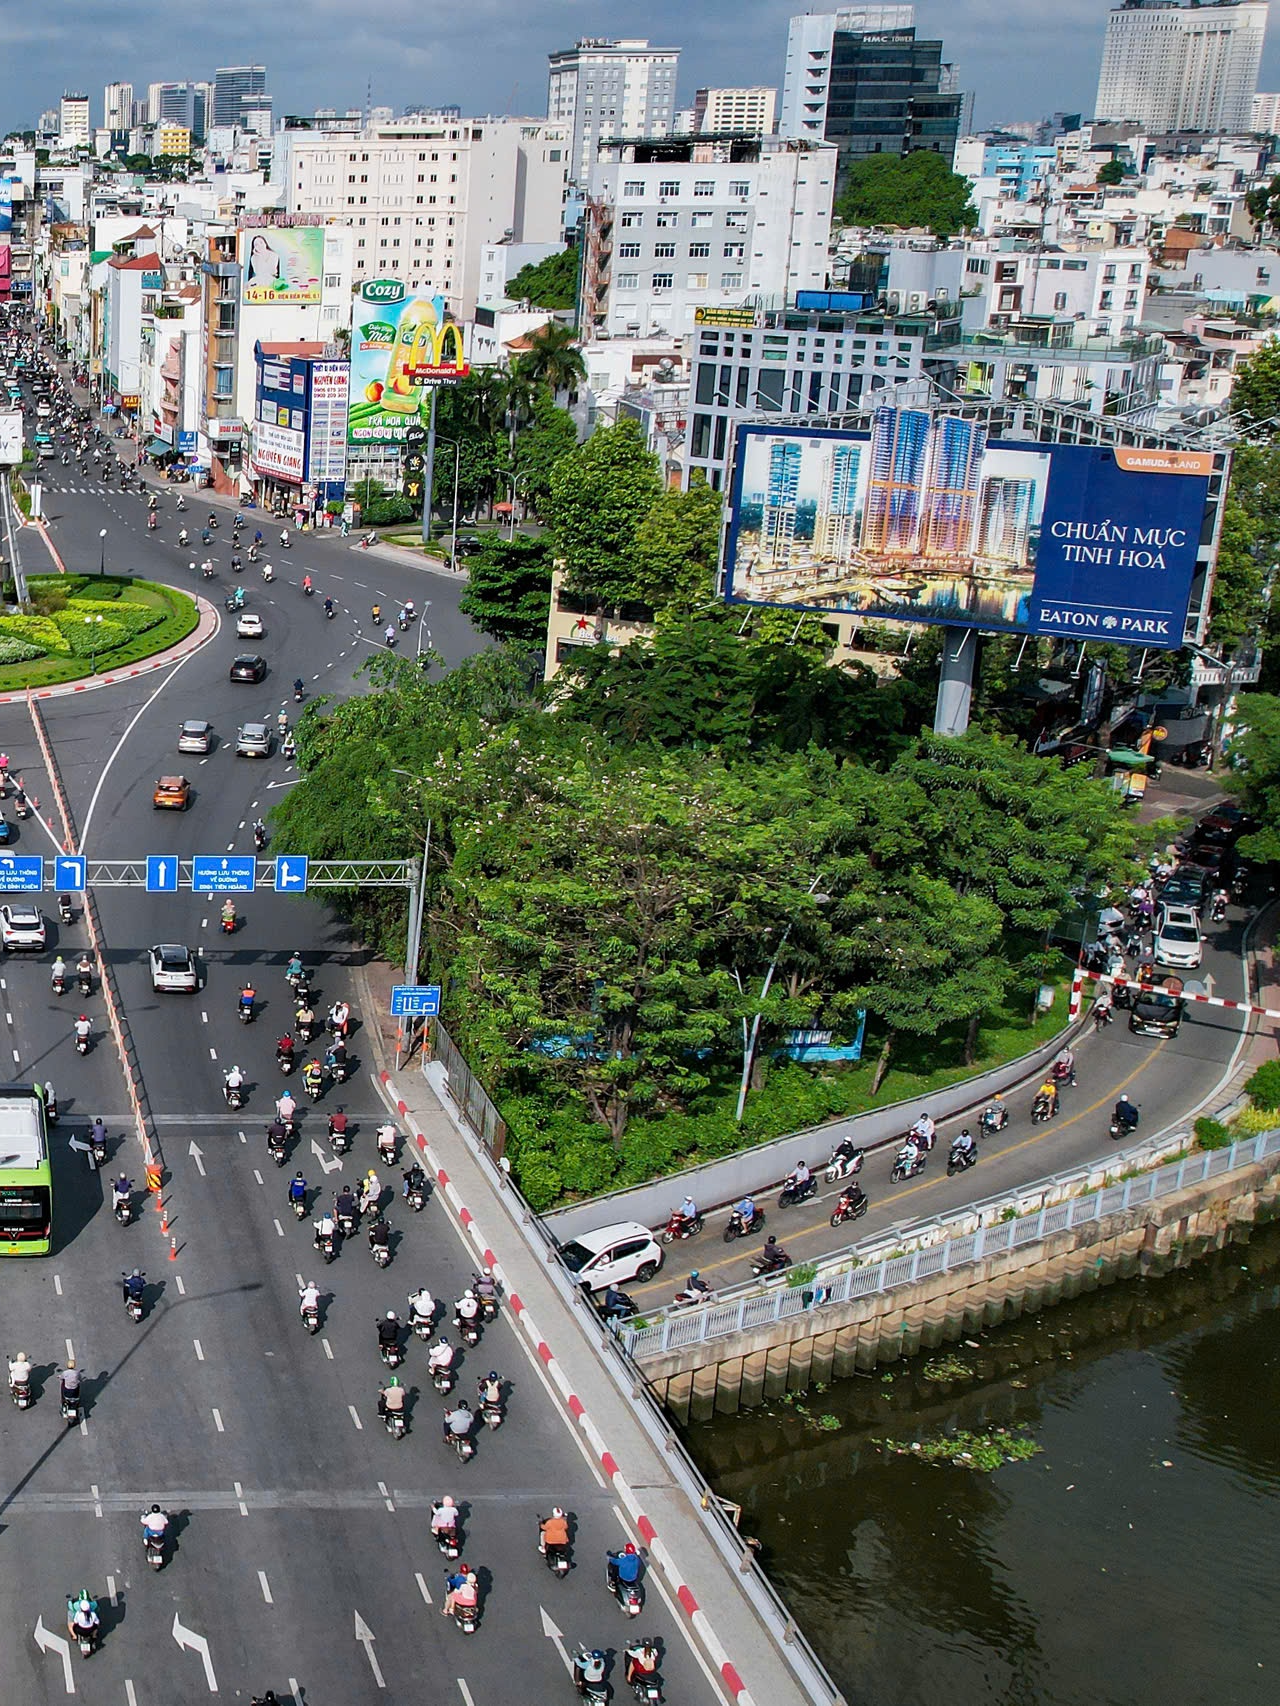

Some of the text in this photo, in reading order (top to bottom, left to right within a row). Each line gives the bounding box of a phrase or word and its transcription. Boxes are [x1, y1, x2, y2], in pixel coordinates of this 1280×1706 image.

[246, 290, 275, 300] 14-16
[366, 283, 402, 298] Cozy
[415, 367, 456, 375] McDonald's
[423, 377, 441, 385] Drive
[1126, 457, 1172, 468] GAMUDA
[1051, 519, 1186, 549] CHUẨN MỰC
[1062, 545, 1166, 570] TINH HOA
[1040, 609, 1169, 634] EATON PARK
